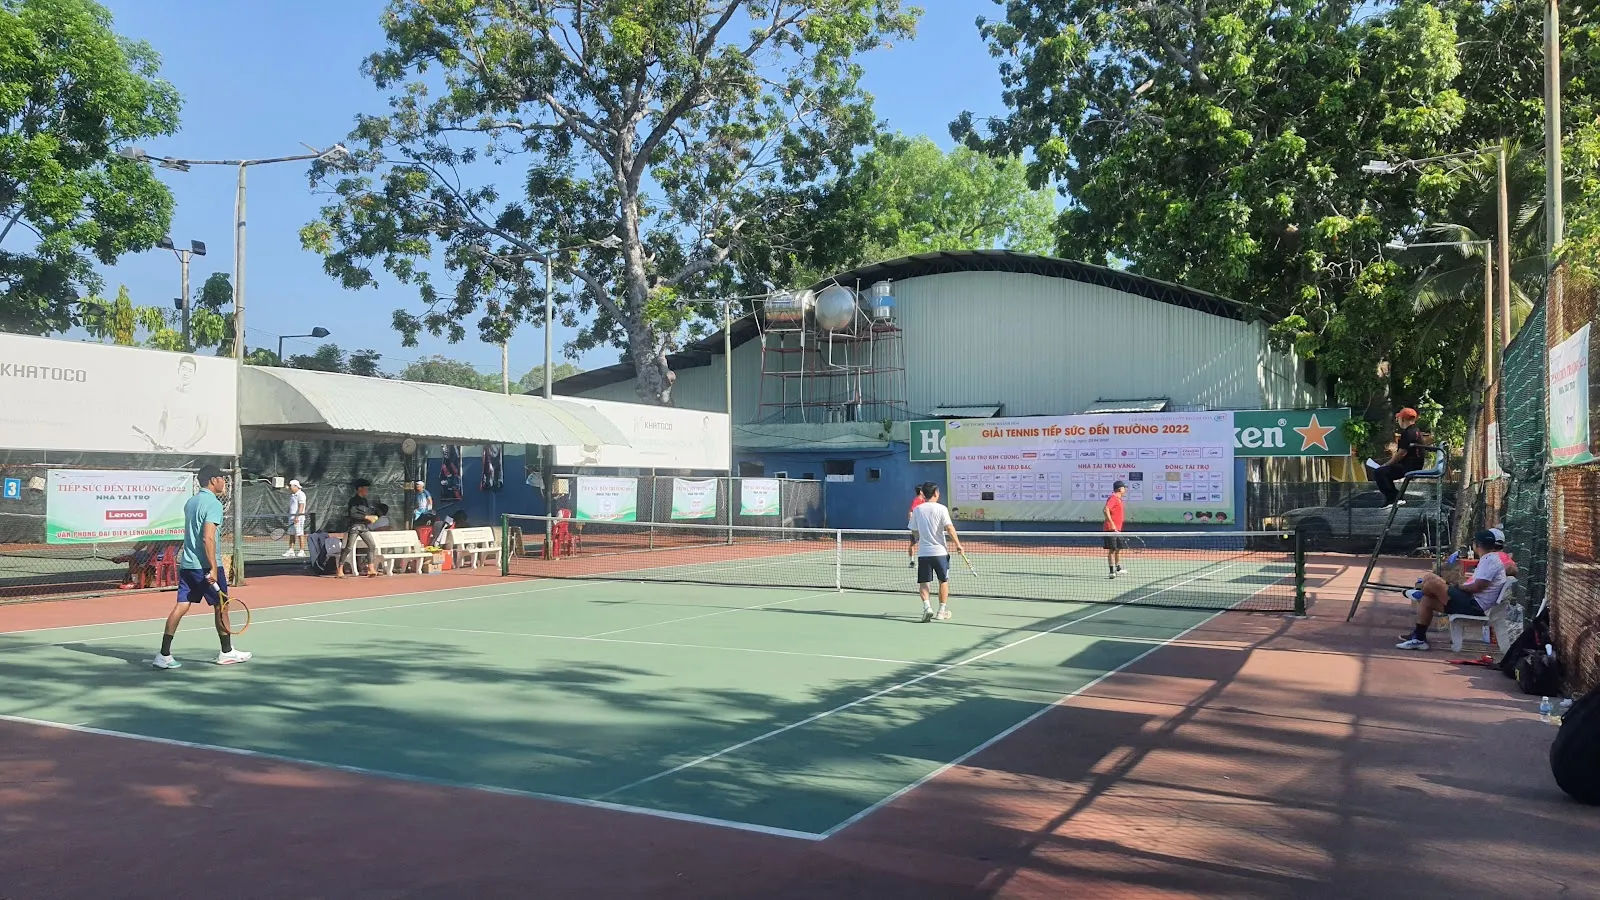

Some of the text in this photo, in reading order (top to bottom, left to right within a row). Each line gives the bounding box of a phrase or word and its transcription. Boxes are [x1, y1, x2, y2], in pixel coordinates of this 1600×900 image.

[0, 363, 87, 382] KHATOCO
[982, 423, 1190, 438] GIẢI TENNIS TIẾP SỨC ĐẾN TRƯỜNG 2022
[8, 481, 17, 496] 3
[109, 511, 144, 519] Lenovo
